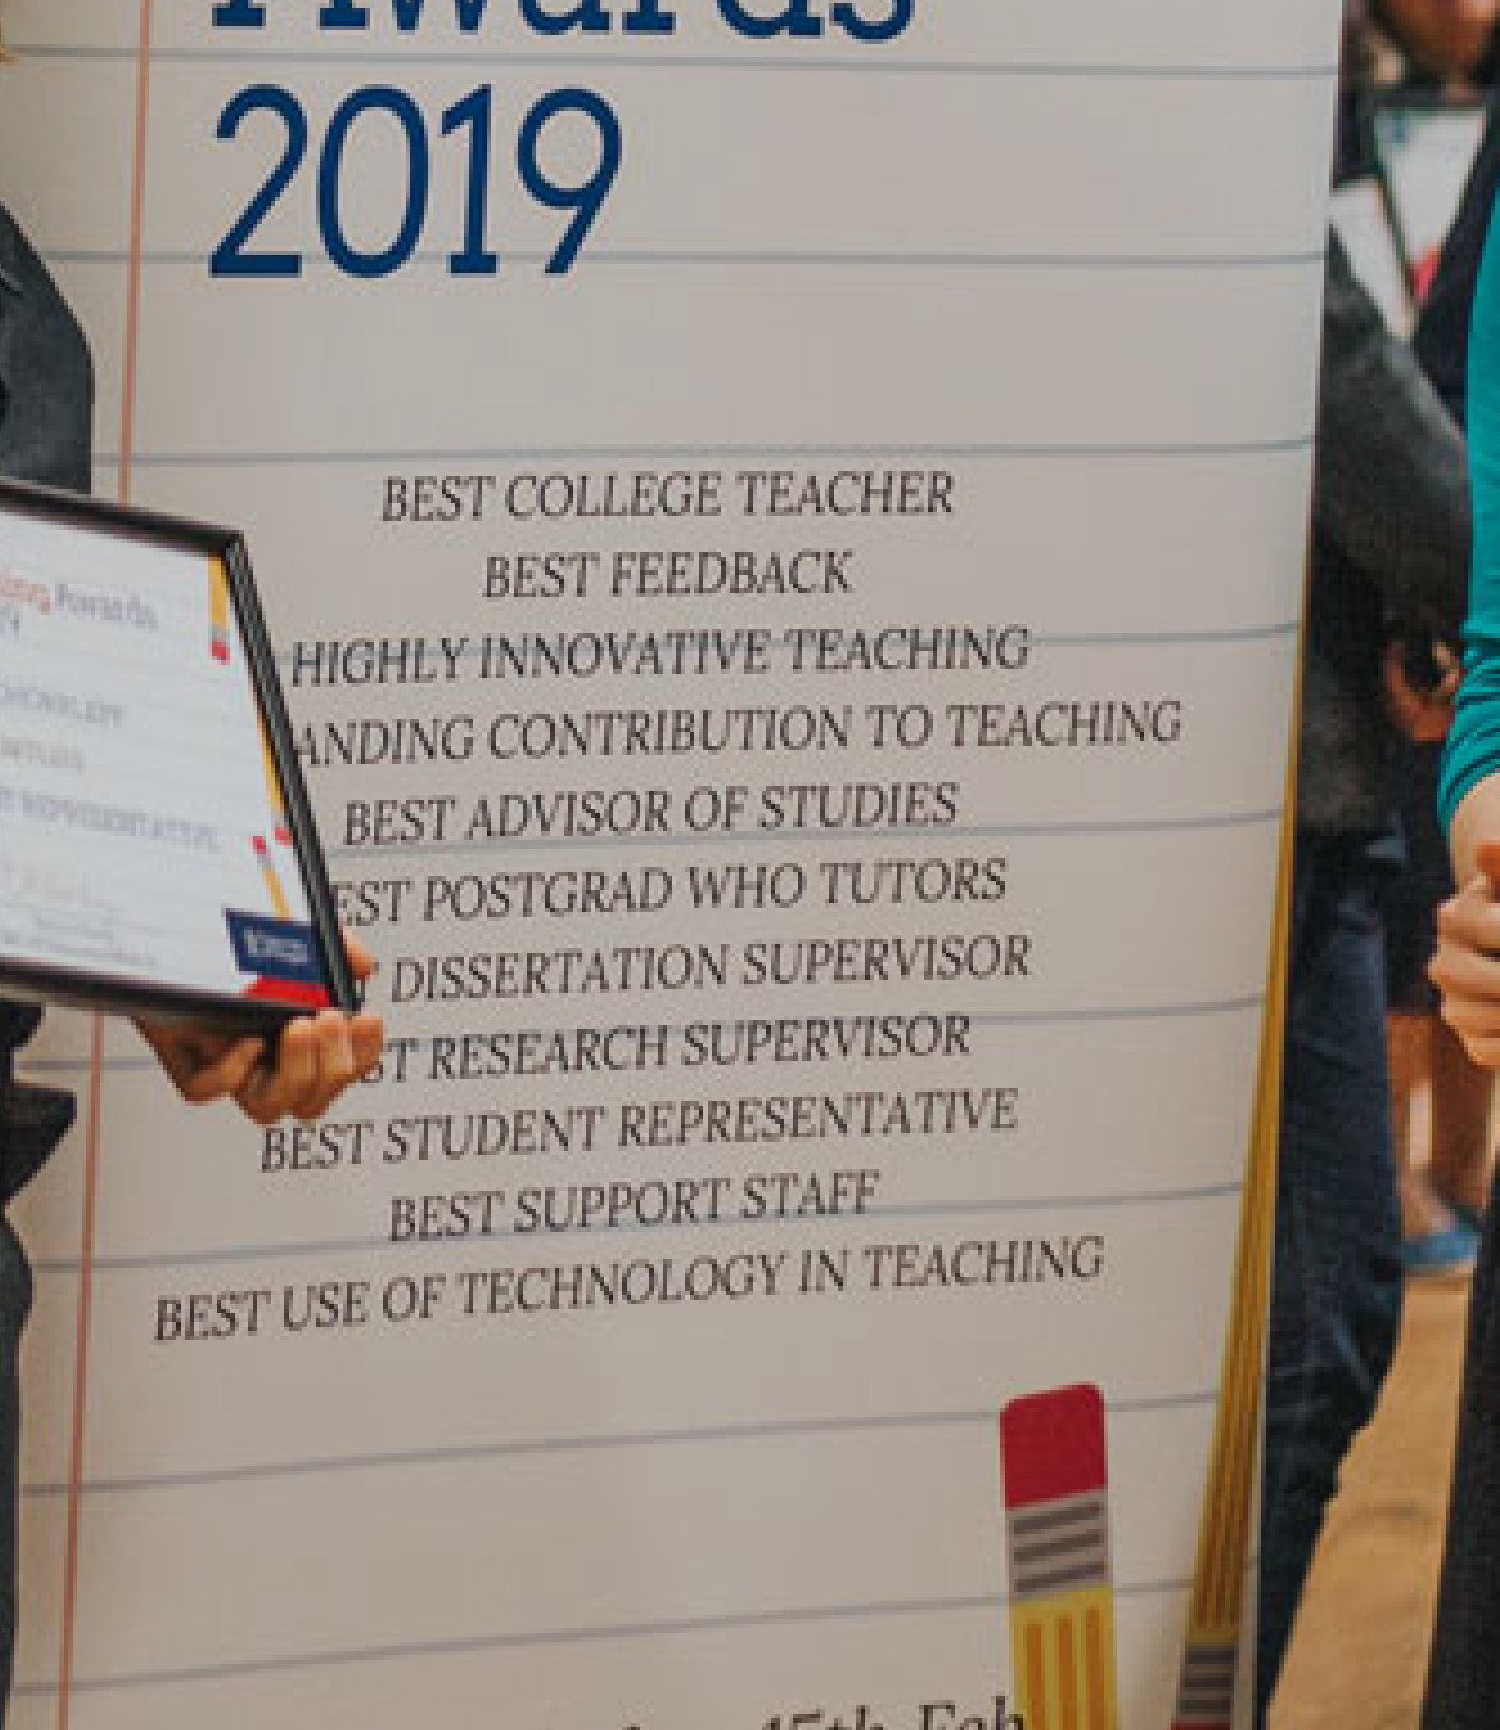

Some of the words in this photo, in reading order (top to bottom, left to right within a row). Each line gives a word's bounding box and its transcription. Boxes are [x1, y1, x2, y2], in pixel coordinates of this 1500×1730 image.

[208, 82, 623, 279] 2019
[382, 474, 496, 523] BEST
[505, 472, 721, 519] COLLEGE
[734, 471, 956, 516] TEACHER
[482, 553, 593, 599] BEST
[609, 550, 854, 597] FEEDBACK
[292, 638, 471, 686] HIGHLY
[480, 630, 765, 680] INNOVATIVE
[787, 625, 1030, 671] TEACHING
[294, 716, 476, 768] ANDING
[487, 705, 858, 760] CONTRIBUTION
[868, 706, 933, 748] TO
[946, 700, 1182, 746] TEACHING
[345, 800, 456, 847] BEST
[466, 791, 669, 841] ADVISOR
[685, 787, 748, 832] OF
[761, 782, 959, 829] STUDIES
[331, 879, 413, 928] EST
[422, 868, 673, 922] POSTGRAD
[690, 863, 804, 907] WHO
[819, 859, 1007, 904] TUTORS
[391, 941, 735, 1003] DISSERTATION
[742, 936, 1032, 988] SUPERVISOR
[430, 1024, 668, 1079] RESEARCH
[682, 1014, 971, 1067] SUPERVISOR
[260, 1123, 372, 1174] BEST
[383, 1106, 604, 1164] STUDENT
[617, 1087, 1019, 1149] REPRESENTATIVE
[388, 1192, 505, 1244] BEST
[514, 1177, 732, 1234] SUPPORT
[741, 1168, 880, 1221] STAFF
[155, 1292, 272, 1342] BEST
[281, 1281, 371, 1332] USE
[382, 1275, 446, 1322] OF
[460, 1252, 795, 1317] TECHNOLOGY
[800, 1251, 852, 1294] IN
[868, 1234, 1105, 1287] TEACHING
